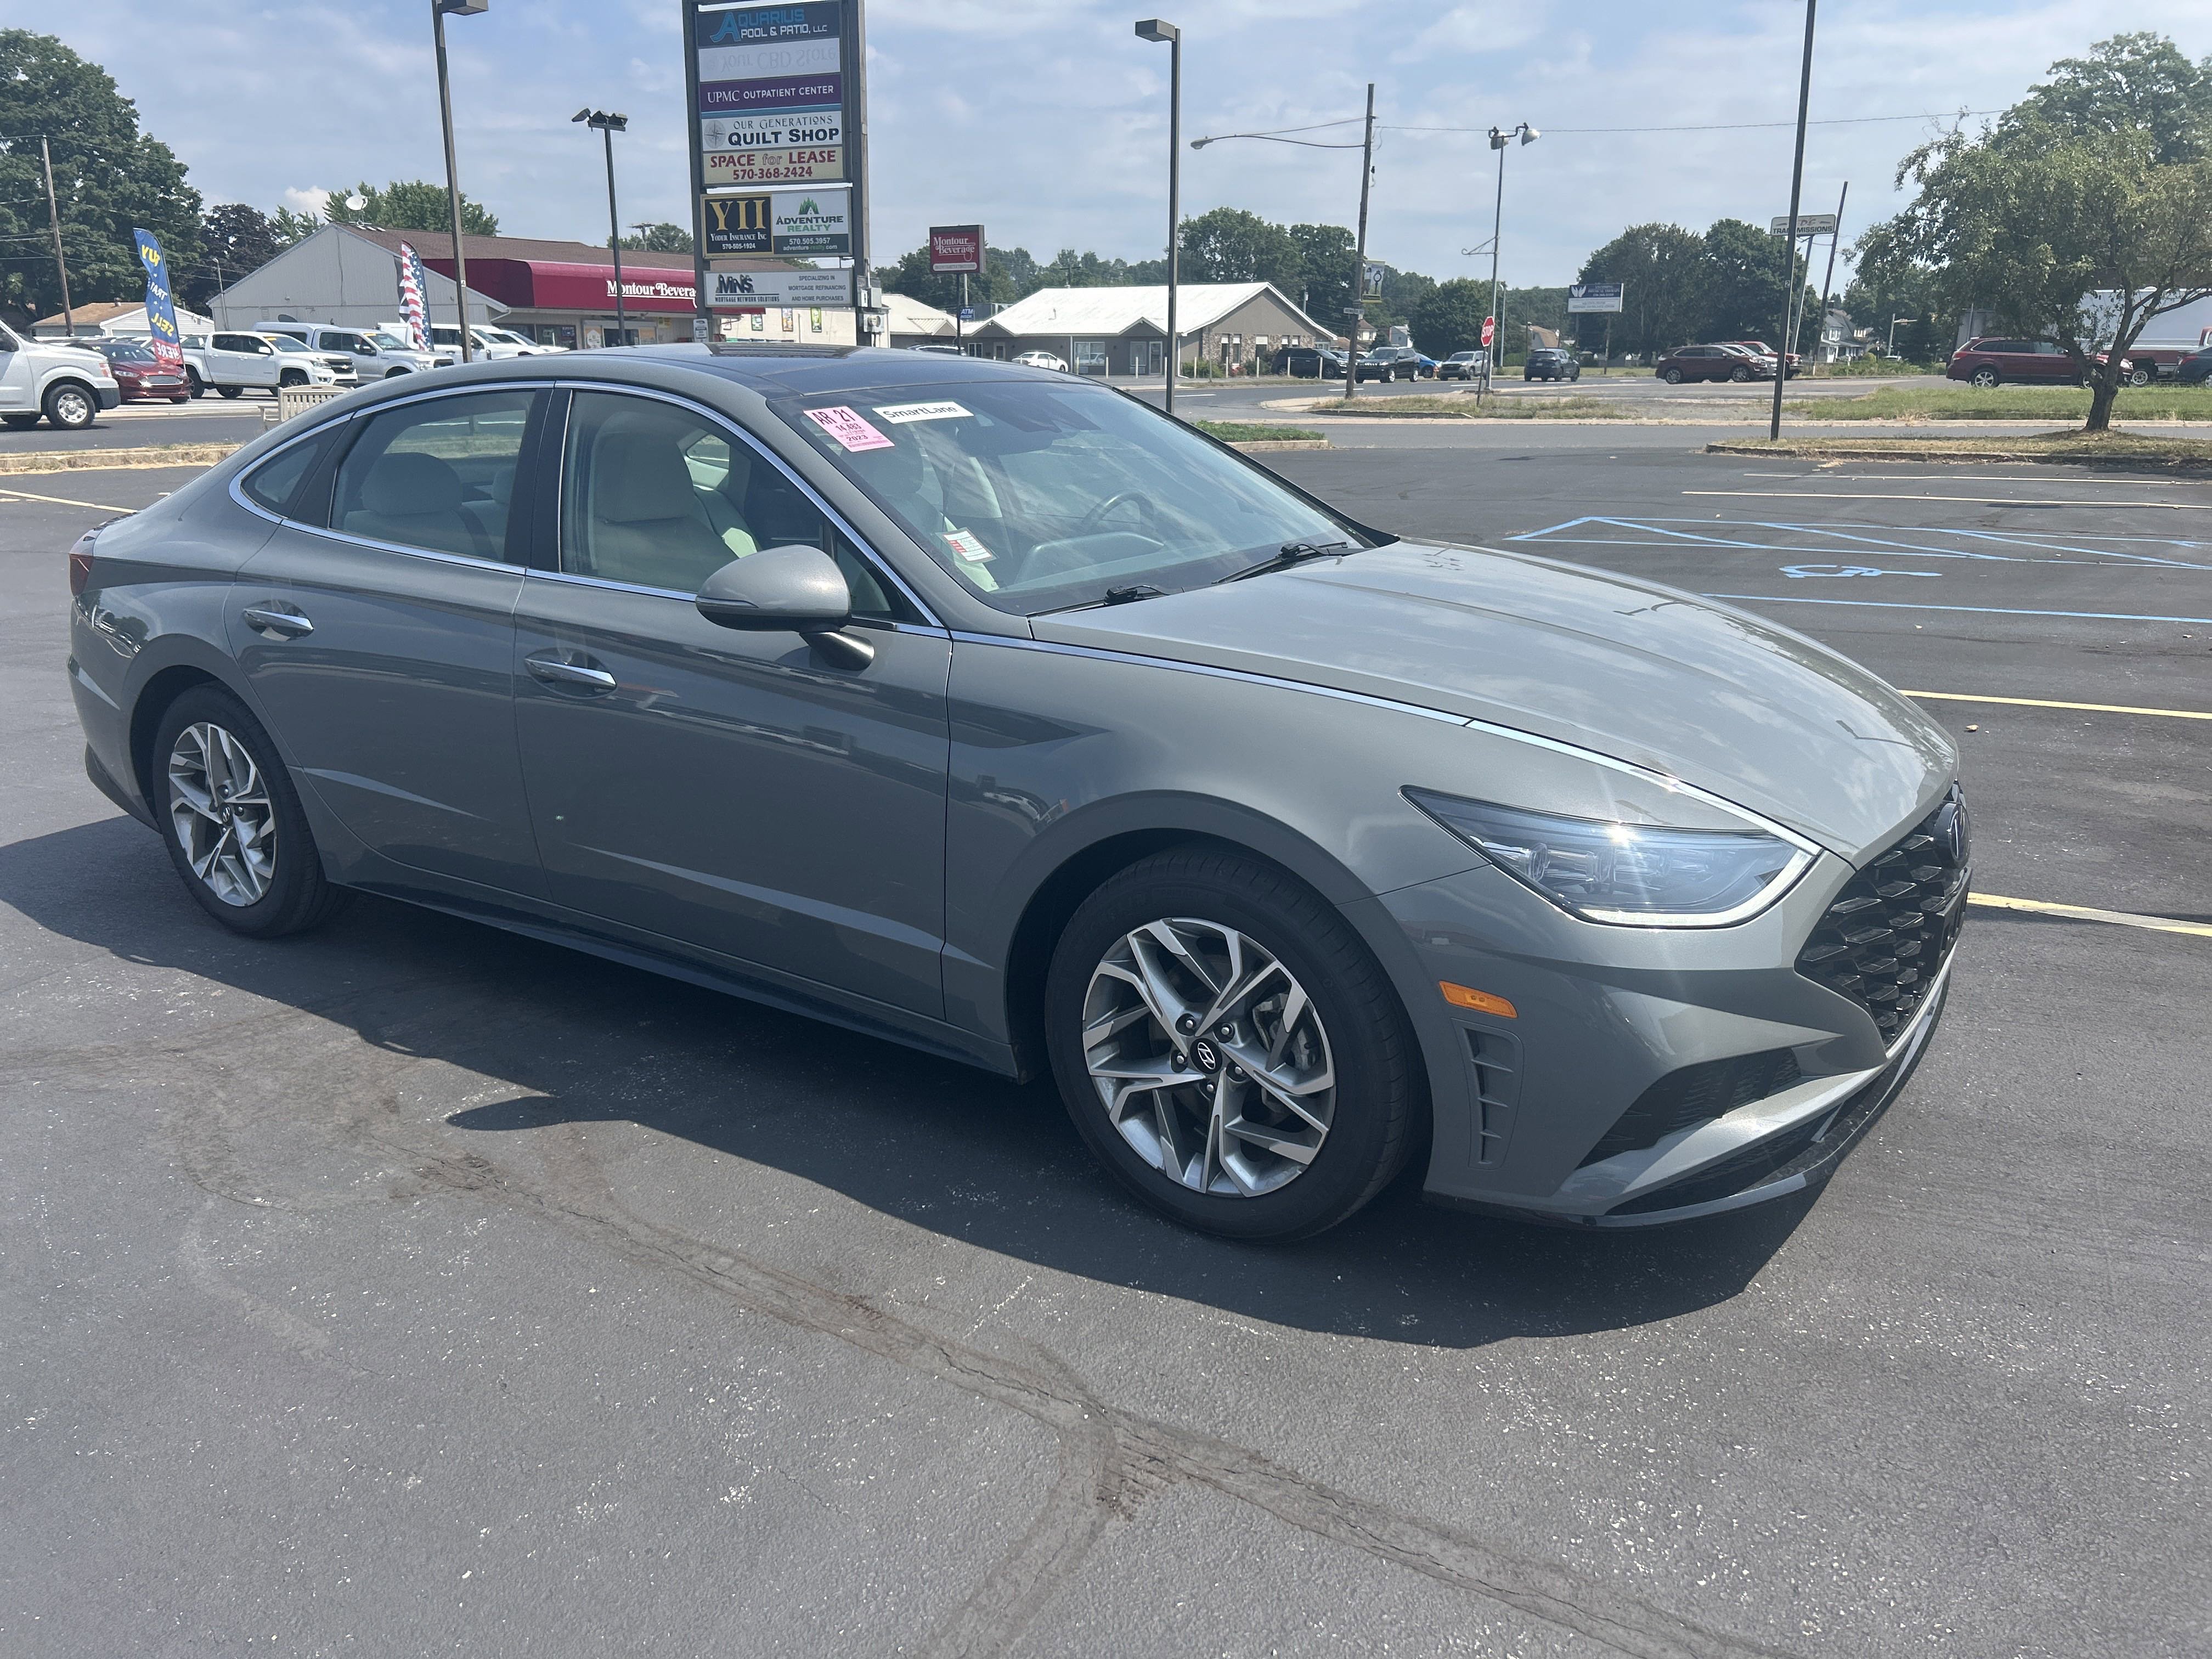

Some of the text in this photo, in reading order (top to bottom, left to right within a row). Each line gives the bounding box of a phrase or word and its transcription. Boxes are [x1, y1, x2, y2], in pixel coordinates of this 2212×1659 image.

[710, 8, 805, 43] AQUARIUS
[741, 24, 827, 39] POOL & PATIO, LLC
[707, 85, 834, 103] UPMC OUTPATIENT CENTER
[733, 115, 833, 129] OUR GENERATIONS
[728, 128, 839, 146] QUILT SHOP
[710, 150, 836, 168] SPACE for LEASE
[733, 166, 812, 180] 570-368-2424
[709, 200, 766, 230] YII
[776, 216, 844, 225] ADVENTURE
[1773, 225, 1832, 234] TRAMISSIONS
[933, 237, 969, 246] Montour
[935, 245, 975, 257] Beverage
[1482, 325, 1493, 337] STOP
[811, 409, 856, 425] AR 21
[883, 407, 958, 418] SmartLane
